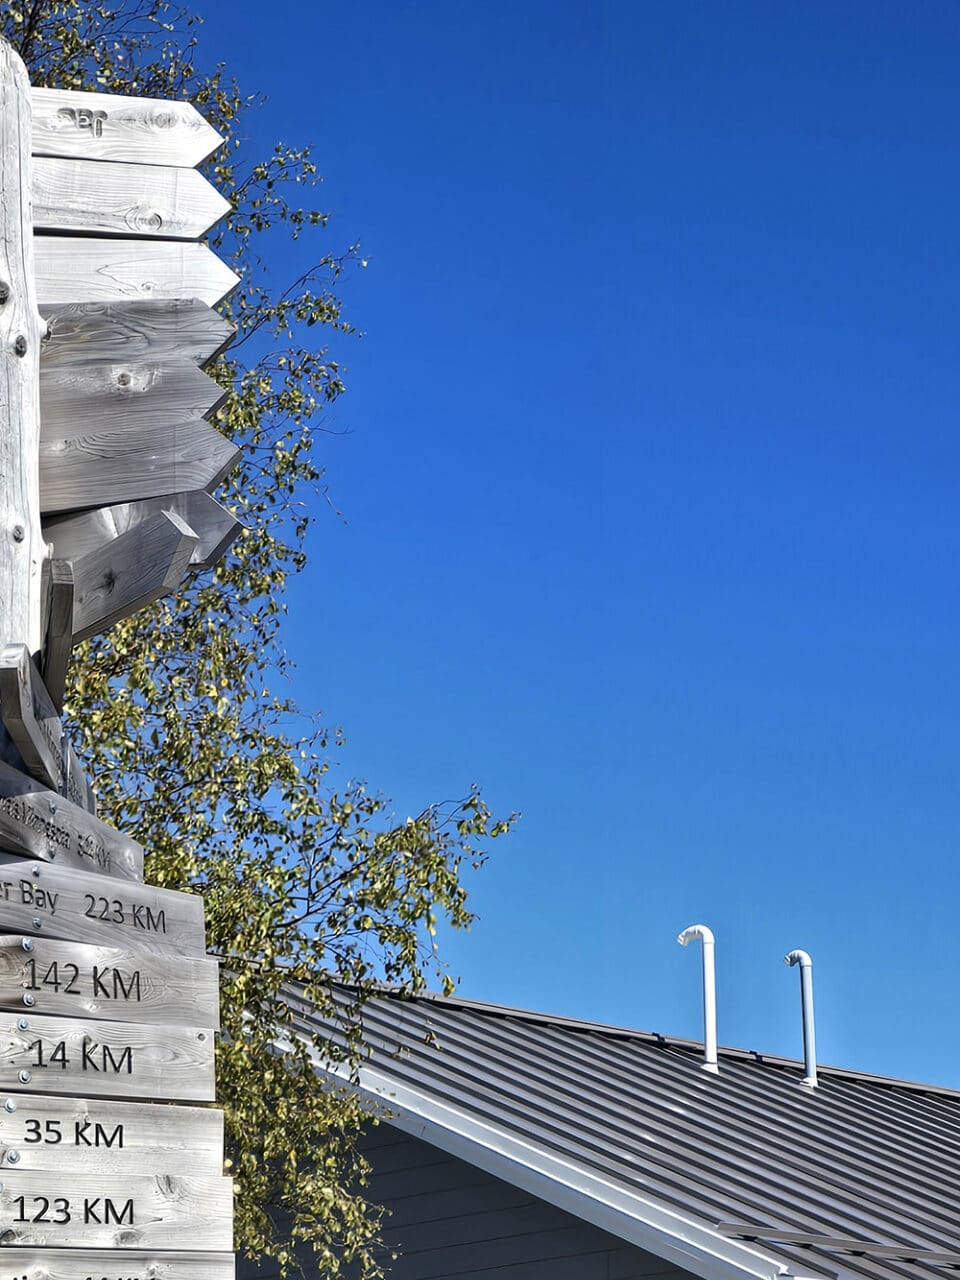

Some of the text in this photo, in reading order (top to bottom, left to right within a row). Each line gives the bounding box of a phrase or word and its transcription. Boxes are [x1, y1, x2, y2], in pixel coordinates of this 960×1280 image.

[20, 879, 59, 915] Bay
[84, 894, 125, 924] 223
[131, 904, 167, 934] KM
[24, 958, 81, 995] 142
[92, 966, 142, 1001] KM
[28, 1039, 70, 1070] 14
[81, 1038, 133, 1074] KM
[23, 1119, 62, 1145] 35
[74, 1122, 124, 1148] KM
[13, 1196, 71, 1225] 123
[83, 1198, 135, 1225] KM
